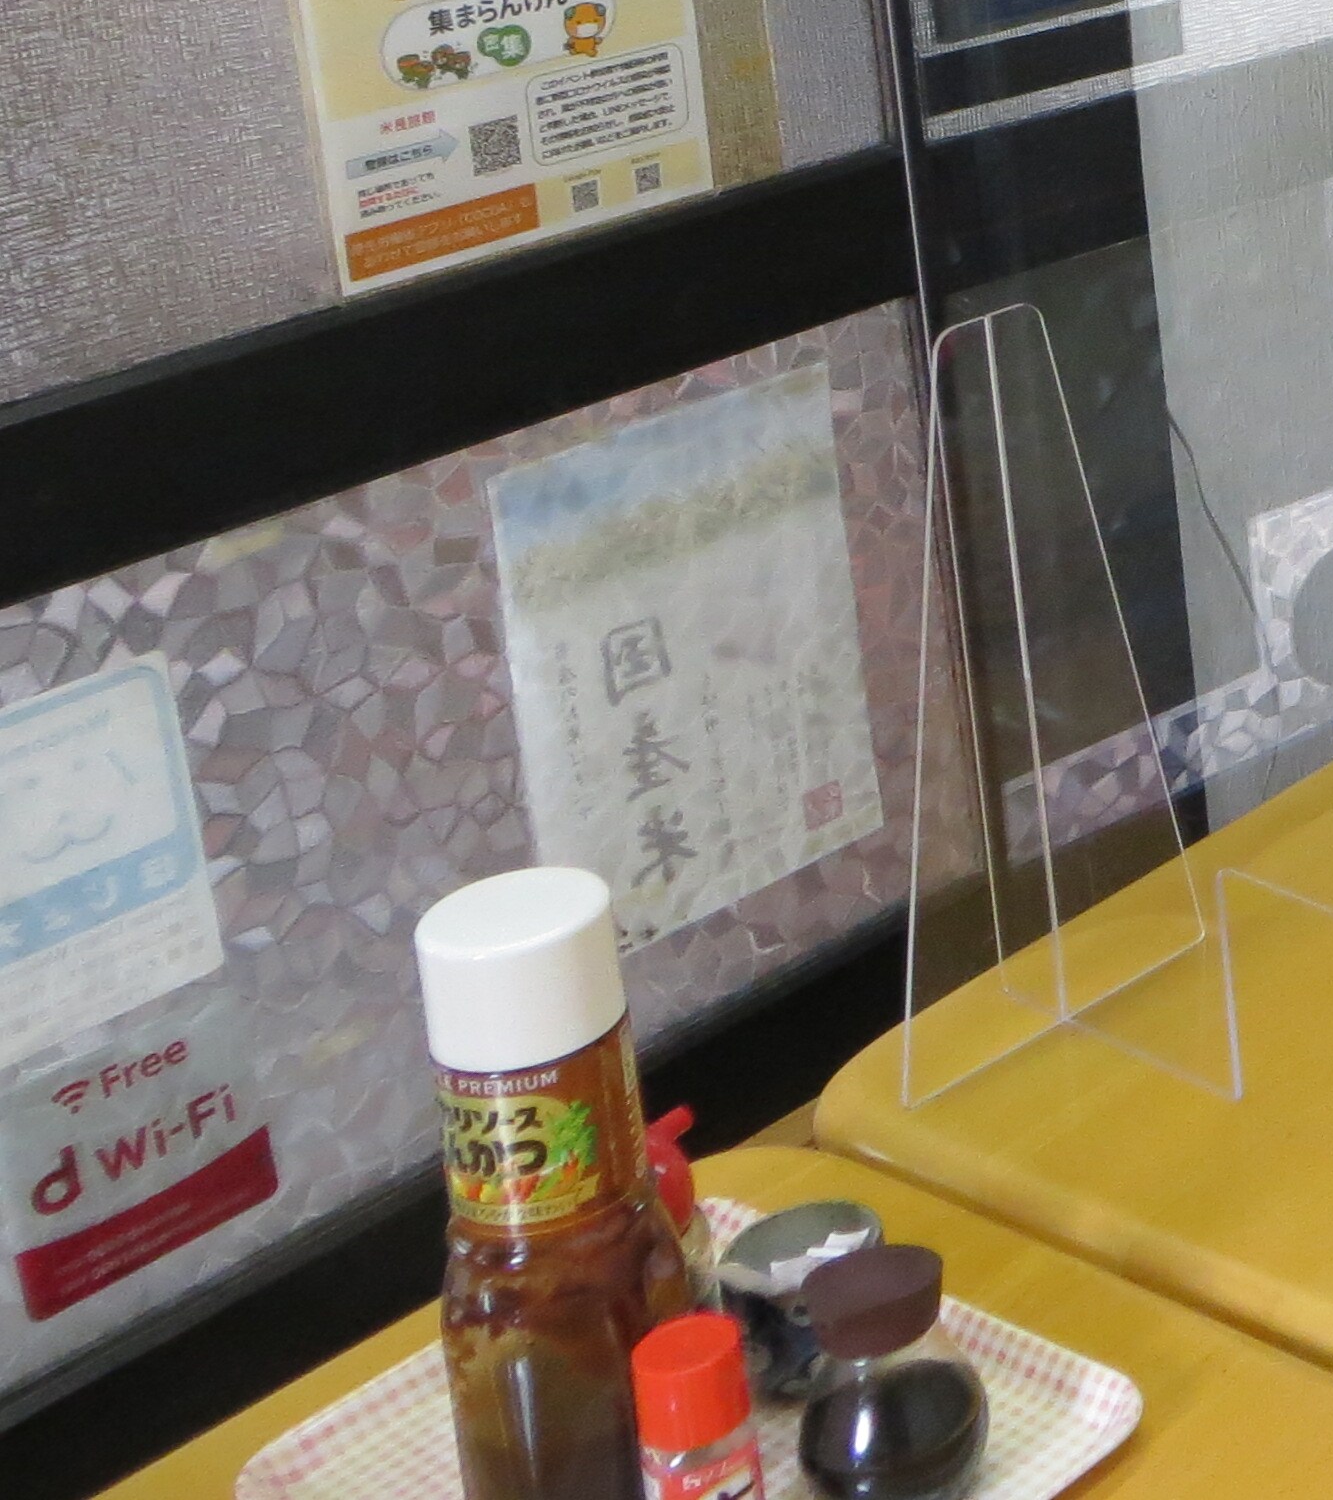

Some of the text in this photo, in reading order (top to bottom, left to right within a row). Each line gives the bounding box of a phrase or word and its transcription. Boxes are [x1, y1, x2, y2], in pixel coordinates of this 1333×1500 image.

[100, 1039, 189, 1099] Free
[458, 1068, 560, 1096] PREMIUM
[31, 1082, 236, 1216] d Wi-Fi
